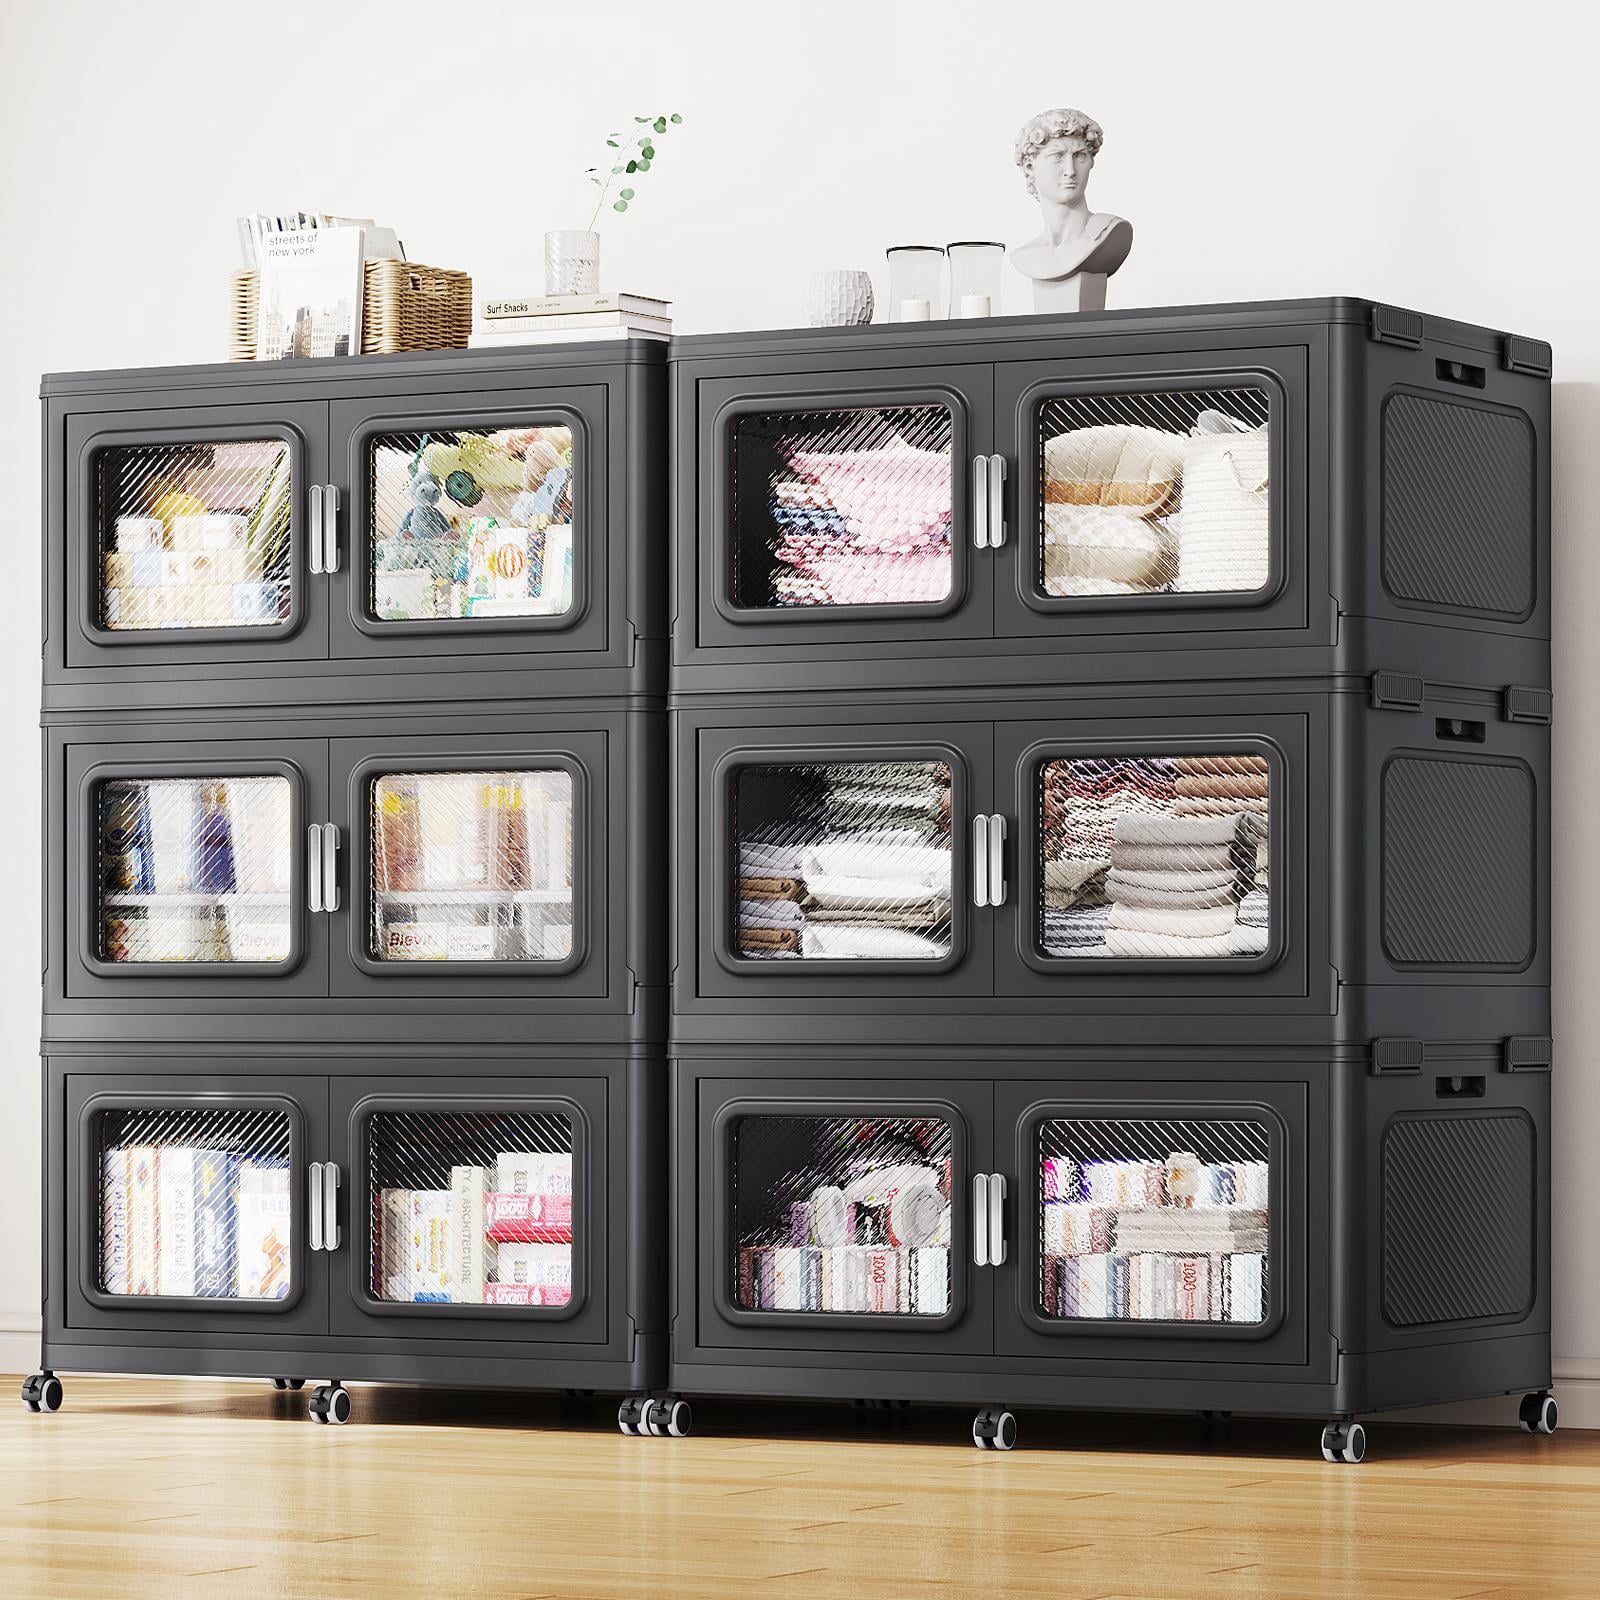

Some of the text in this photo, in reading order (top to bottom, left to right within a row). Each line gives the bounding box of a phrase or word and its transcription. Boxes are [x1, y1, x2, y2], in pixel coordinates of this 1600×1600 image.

[269, 232, 319, 246] streets of
[268, 244, 315, 257] new york
[486, 303, 502, 314] Surf
[461, 1198, 472, 1285] ARCHITECTURE
